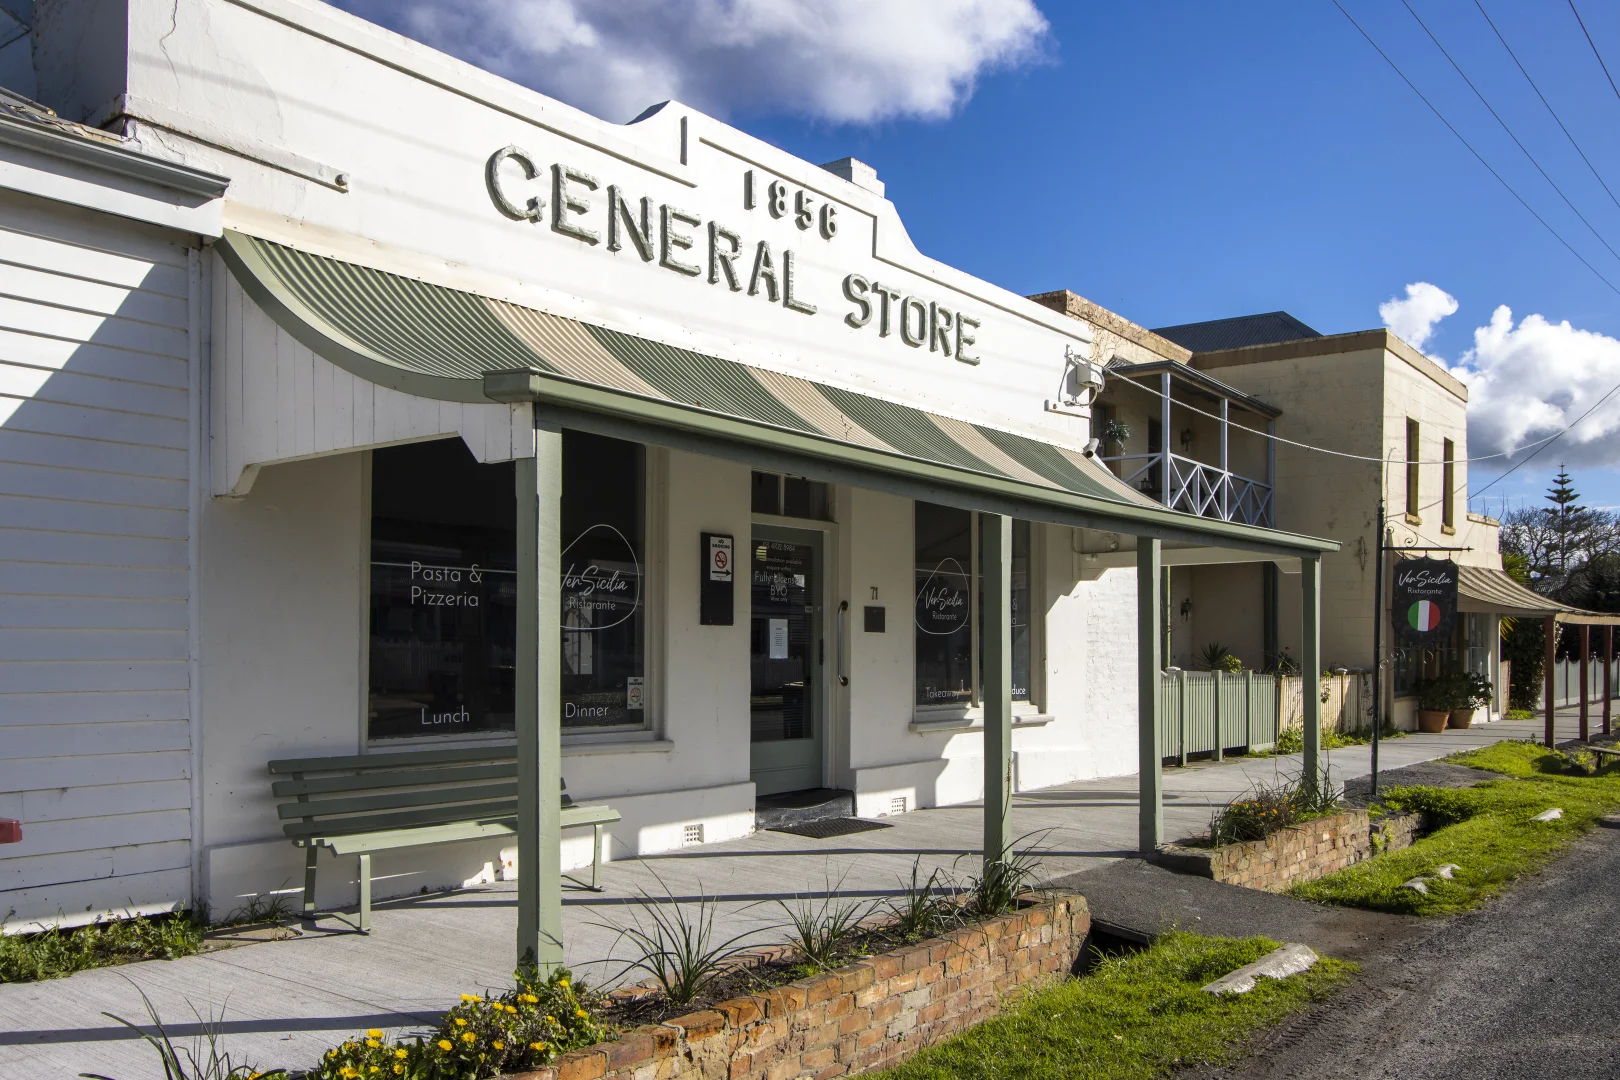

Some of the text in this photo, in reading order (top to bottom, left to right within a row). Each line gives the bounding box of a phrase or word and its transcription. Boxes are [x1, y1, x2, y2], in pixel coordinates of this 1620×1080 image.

[744, 169, 838, 240] 1856
[485, 144, 982, 366] GENERAL STORE
[411, 561, 482, 583] Pasta &
[754, 571, 771, 584] Fully
[411, 586, 479, 607] Pizzeria
[770, 585, 788, 596] BYO
[870, 586, 878, 600] 71
[1407, 586, 1443, 595] Ristorante
[569, 596, 616, 611] Ristorante
[932, 610, 957, 621] Ristorante
[925, 686, 960, 699] Takeaway
[421, 704, 470, 725] Lunch
[565, 702, 608, 718] Dinner
